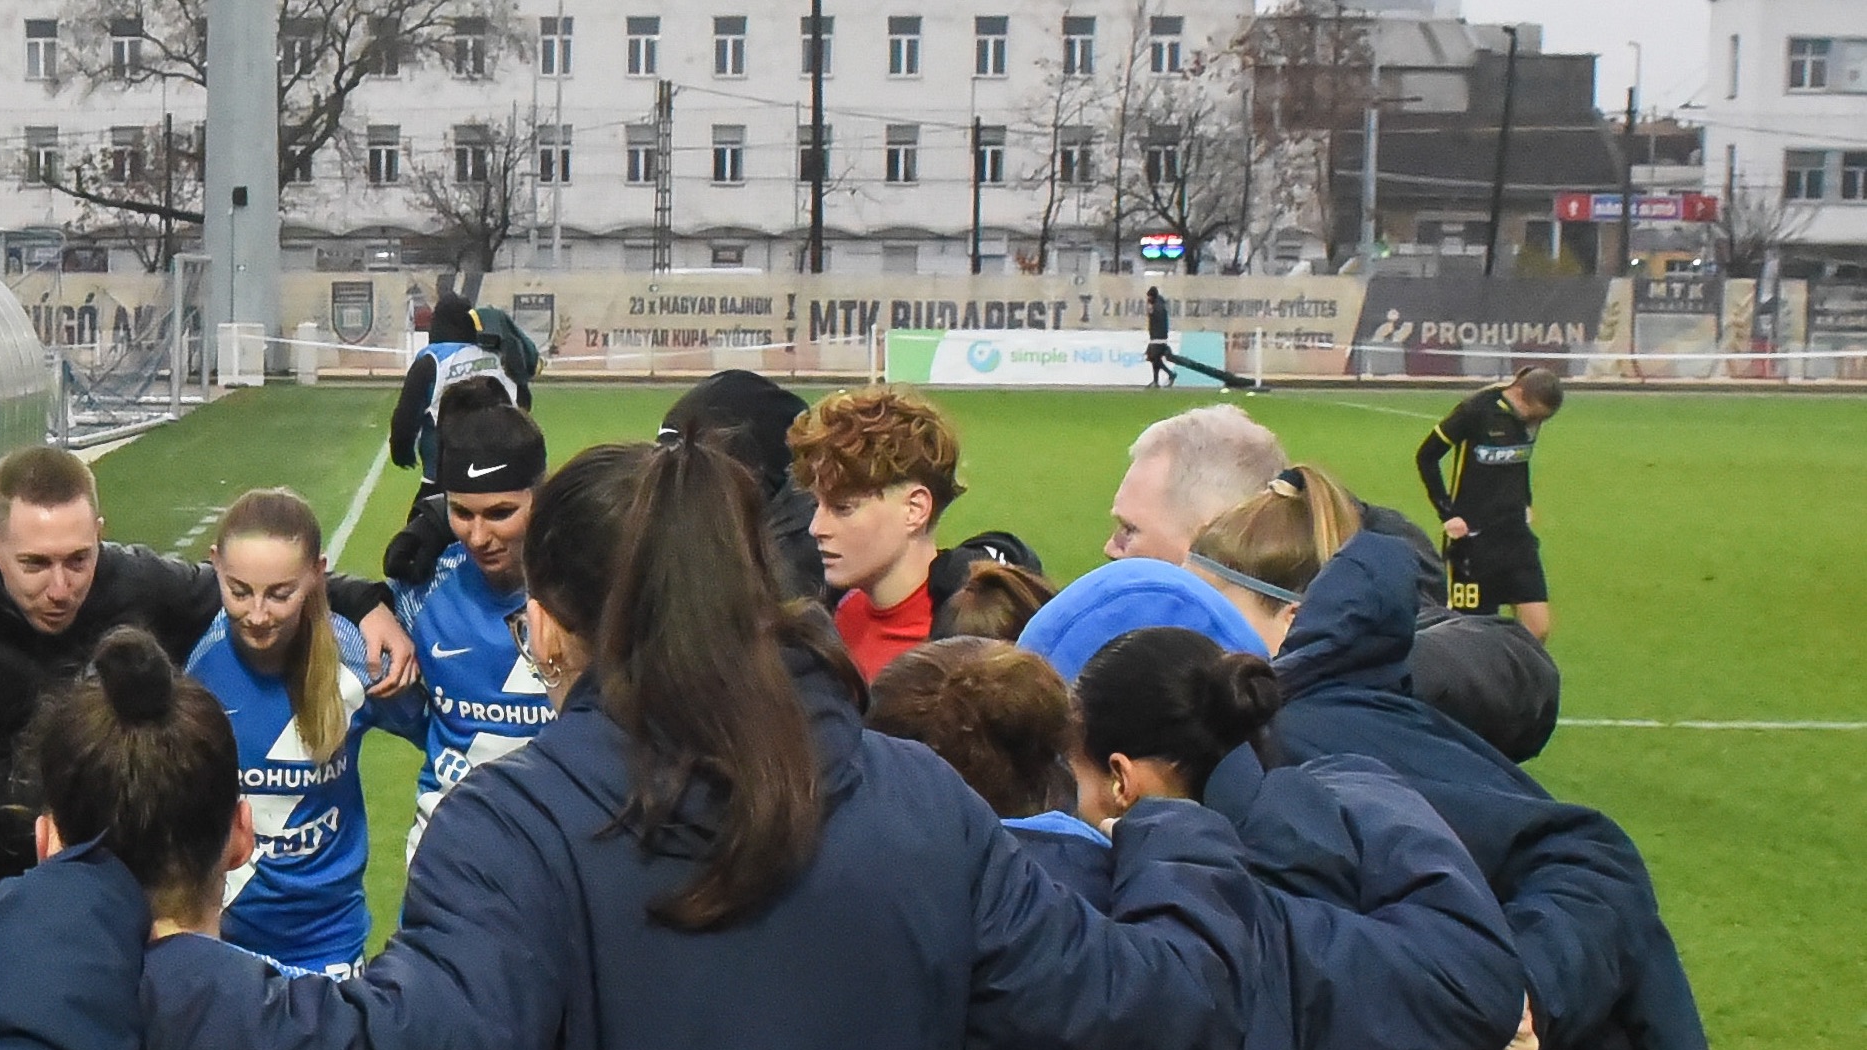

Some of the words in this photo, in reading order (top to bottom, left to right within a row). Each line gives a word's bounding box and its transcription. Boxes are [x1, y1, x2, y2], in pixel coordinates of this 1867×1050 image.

[630, 297, 644, 315] 23
[660, 297, 716, 315] MAGYAR
[720, 297, 773, 315] BAJNOK
[810, 300, 881, 344] MTK
[1421, 321, 1585, 345] PROHUMAN
[585, 328, 599, 347] 12
[614, 328, 668, 347] MAGYAR
[672, 324, 772, 347] KUPA-GYŐZTES
[1011, 348, 1068, 366] simple
[1453, 583, 1479, 608] 88
[459, 701, 559, 724] PROHUM
[239, 755, 347, 788] OHUMAN
